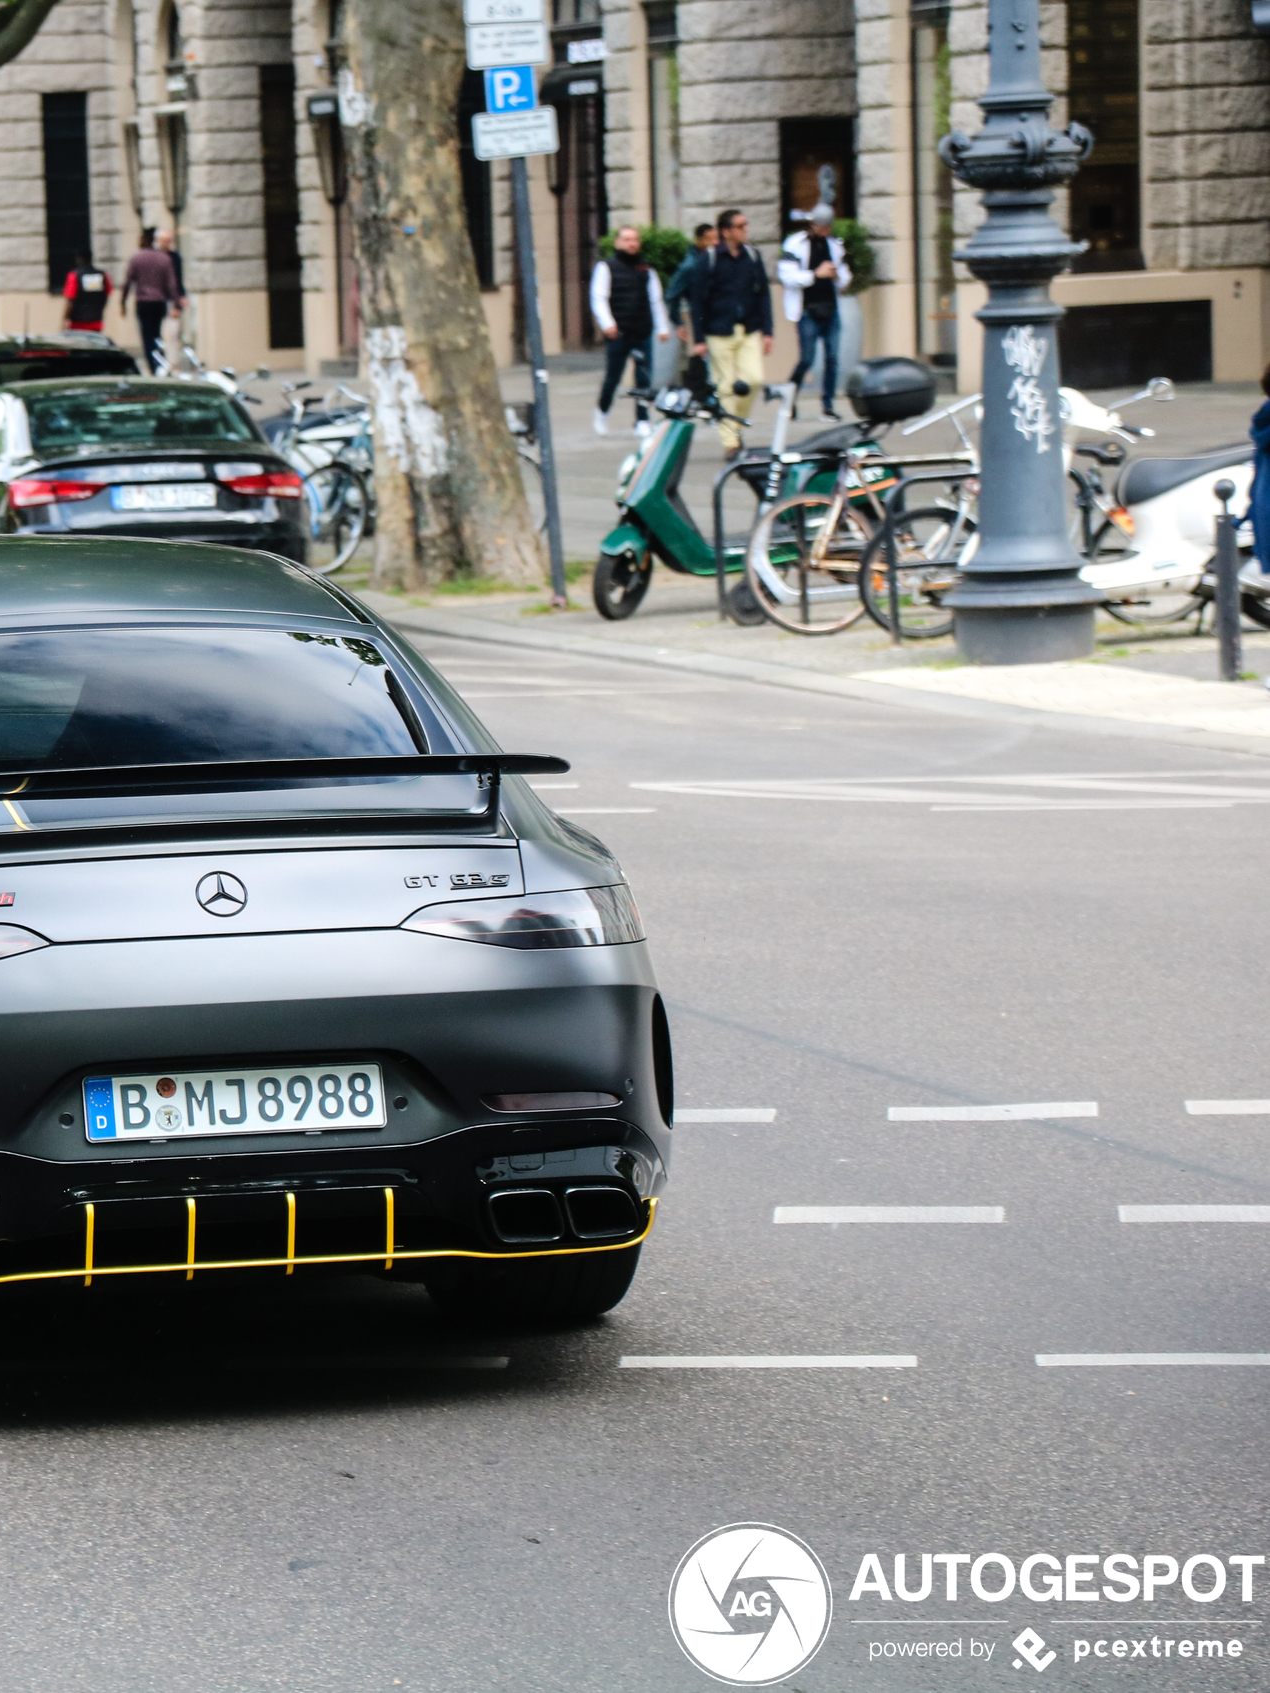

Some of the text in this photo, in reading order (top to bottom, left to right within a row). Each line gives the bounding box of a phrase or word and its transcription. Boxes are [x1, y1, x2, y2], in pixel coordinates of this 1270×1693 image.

[493, 71, 521, 108] P
[404, 875, 439, 888] GT
[119, 1083, 152, 1130] B
[96, 1115, 109, 1130] D
